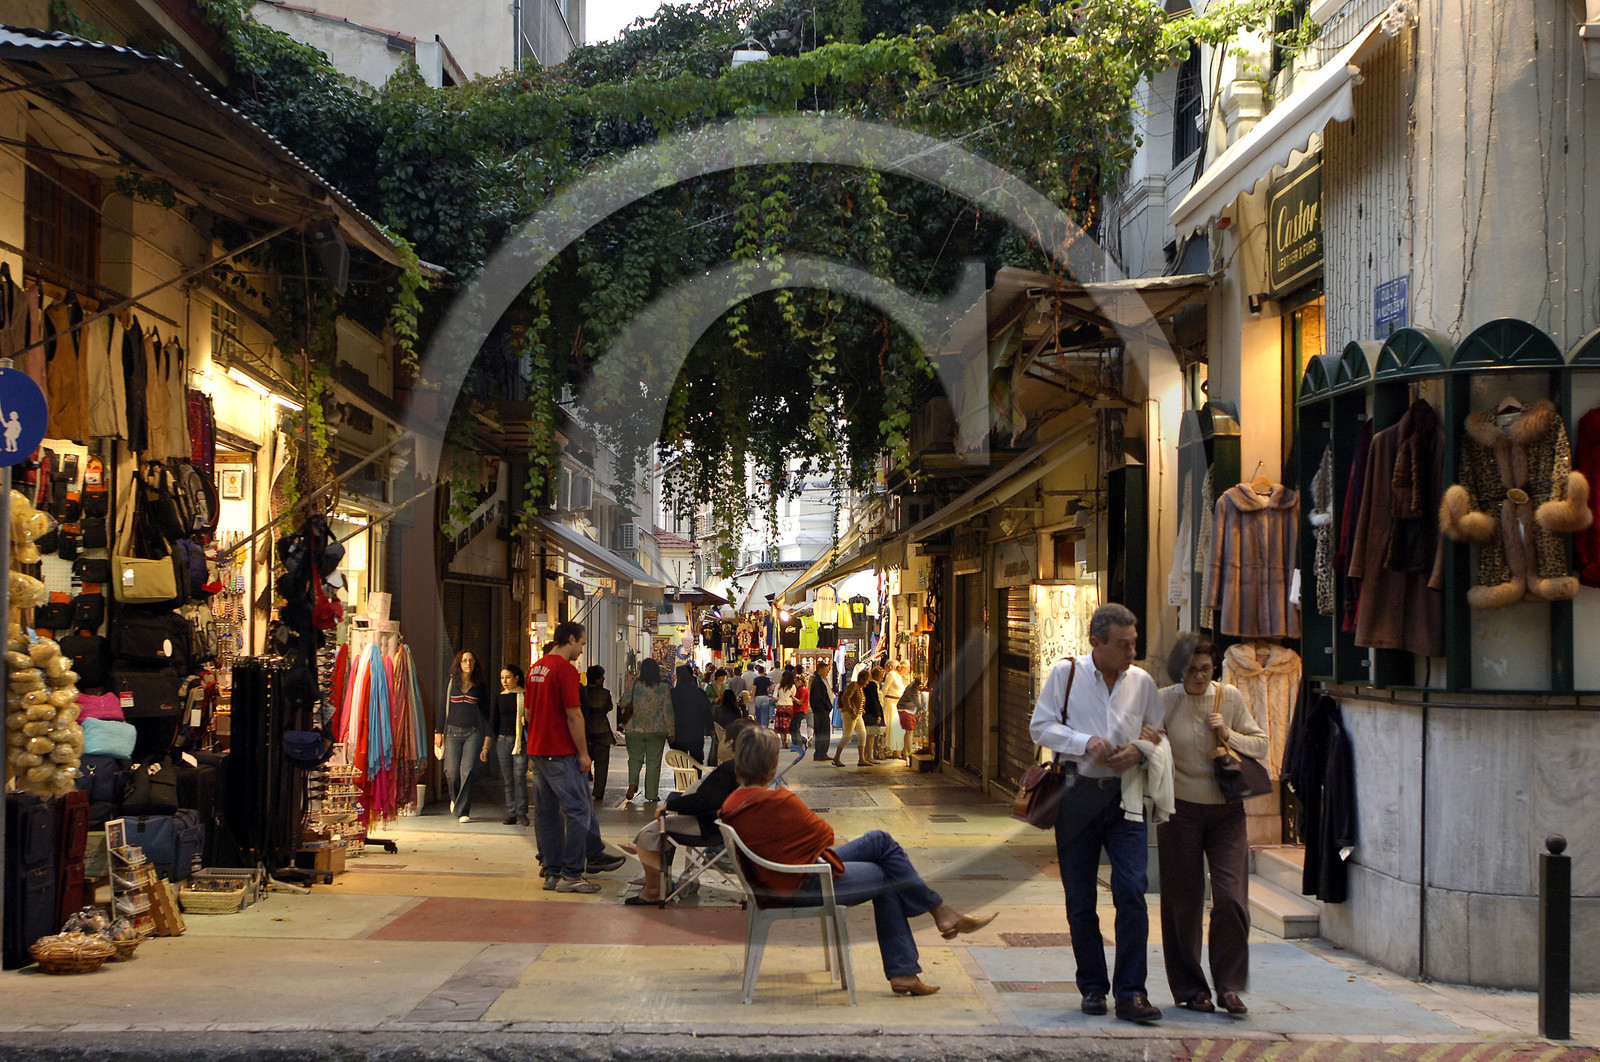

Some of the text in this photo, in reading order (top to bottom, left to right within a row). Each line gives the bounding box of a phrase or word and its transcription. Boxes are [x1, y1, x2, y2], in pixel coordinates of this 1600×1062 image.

[1277, 199, 1318, 252] Castor
[1277, 248, 1299, 273] LEATHER
[1303, 238, 1317, 257] FURS
